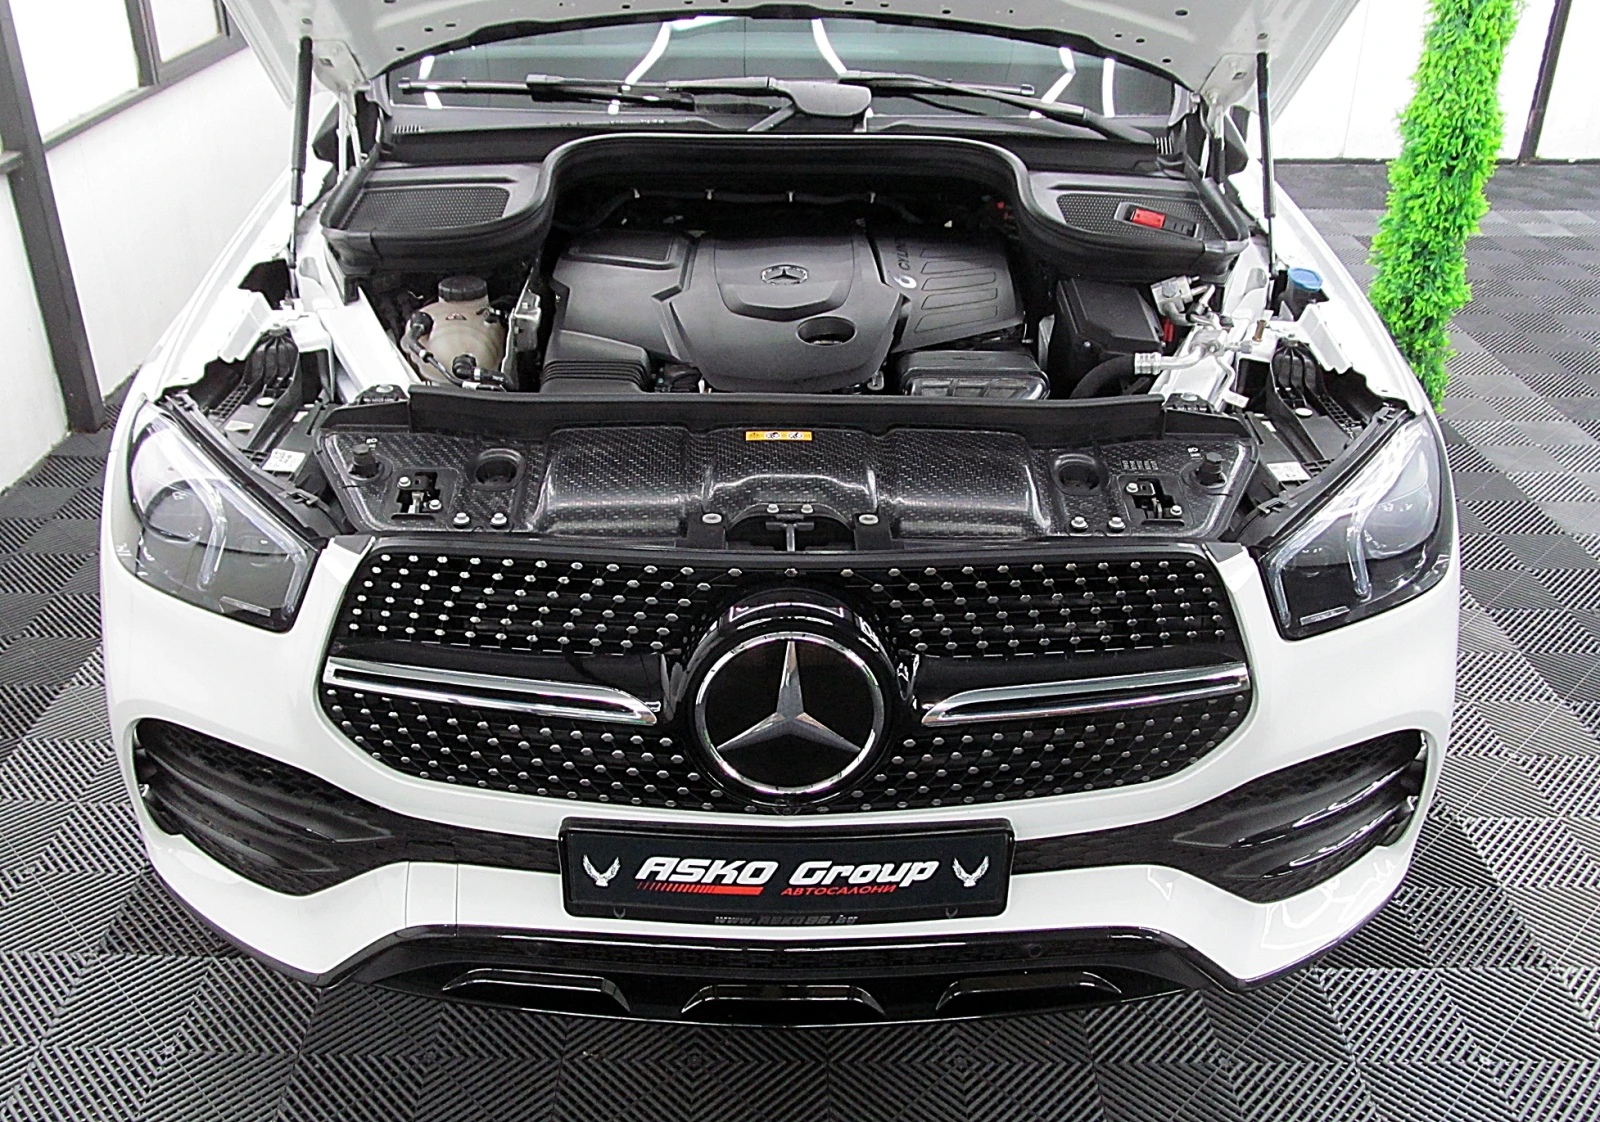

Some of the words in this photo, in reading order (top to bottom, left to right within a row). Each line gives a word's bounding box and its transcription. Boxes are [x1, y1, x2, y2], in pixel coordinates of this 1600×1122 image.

[892, 274, 918, 289] 6
[634, 856, 779, 885] ASKO
[788, 860, 940, 888] Group
[780, 884, 898, 896] АВТОСАЛОНИ
